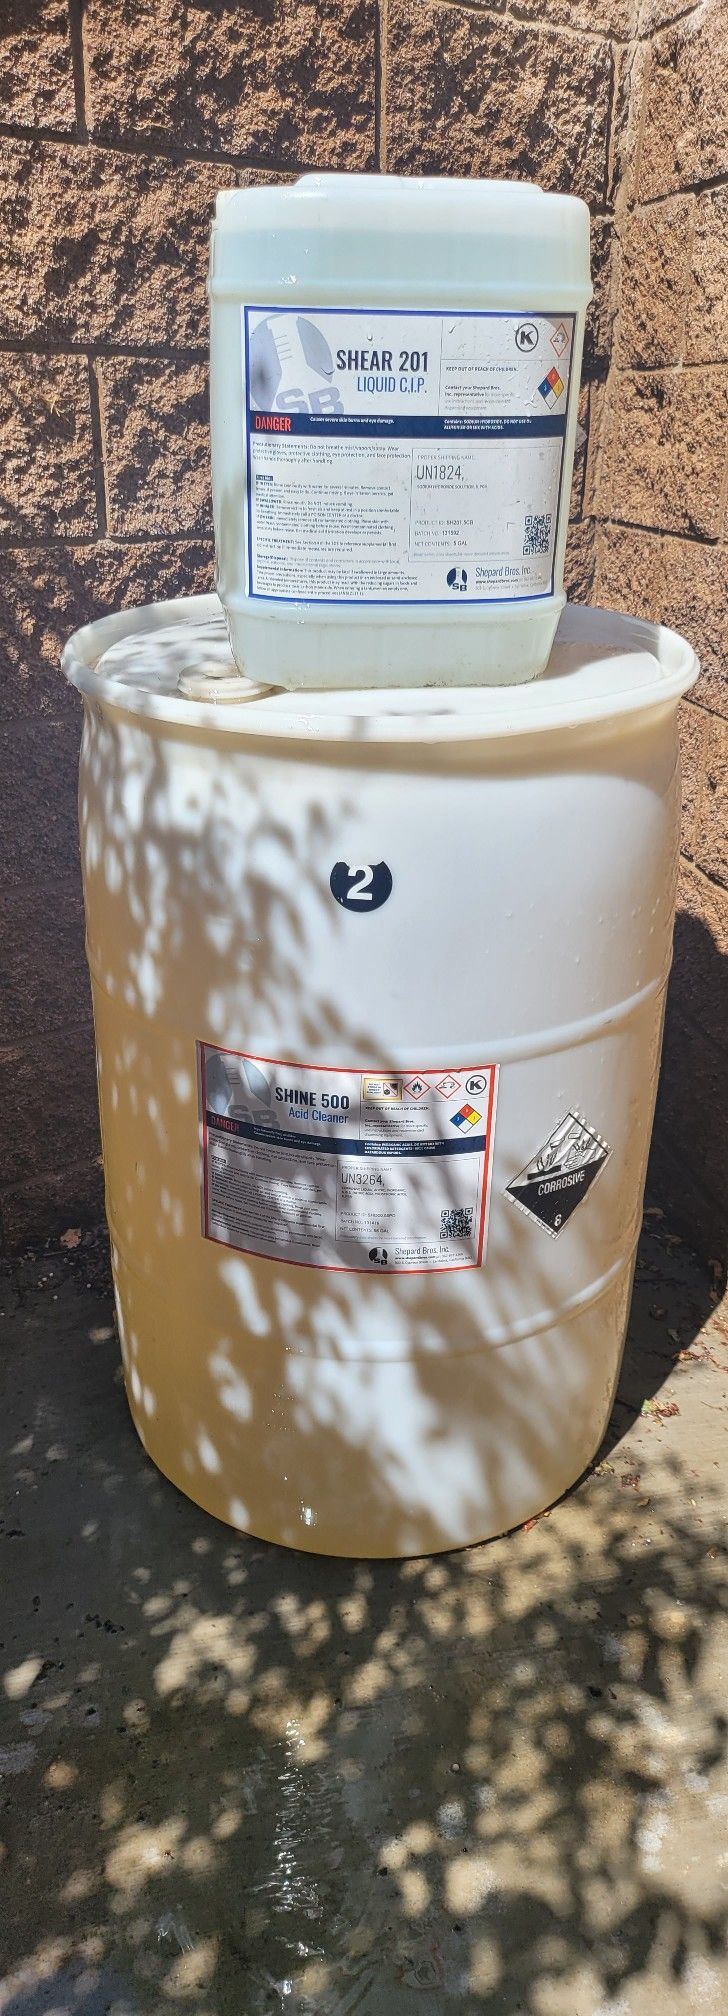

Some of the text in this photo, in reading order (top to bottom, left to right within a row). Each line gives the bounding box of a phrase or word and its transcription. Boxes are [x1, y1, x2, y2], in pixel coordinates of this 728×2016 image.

[520, 330, 534, 346] K
[336, 349, 428, 372] SHEAR 201
[357, 376, 428, 394] LIQUID C.I.P.
[255, 416, 292, 432] DANGER
[416, 464, 464, 482] UN1824,
[476, 566, 502, 580] Shepard
[504, 566, 520, 578] Bros.
[452, 582, 468, 592] SB
[346, 864, 374, 901] 2
[470, 1080, 482, 1090] K
[275, 1086, 350, 1110] SHINE 500
[288, 1106, 350, 1124] Acid Cleaner
[210, 1116, 240, 1133] DANGER
[342, 1173, 385, 1187] UN3264,
[538, 1170, 586, 1196] CORROSIVE
[394, 1247, 421, 1256] Shepard
